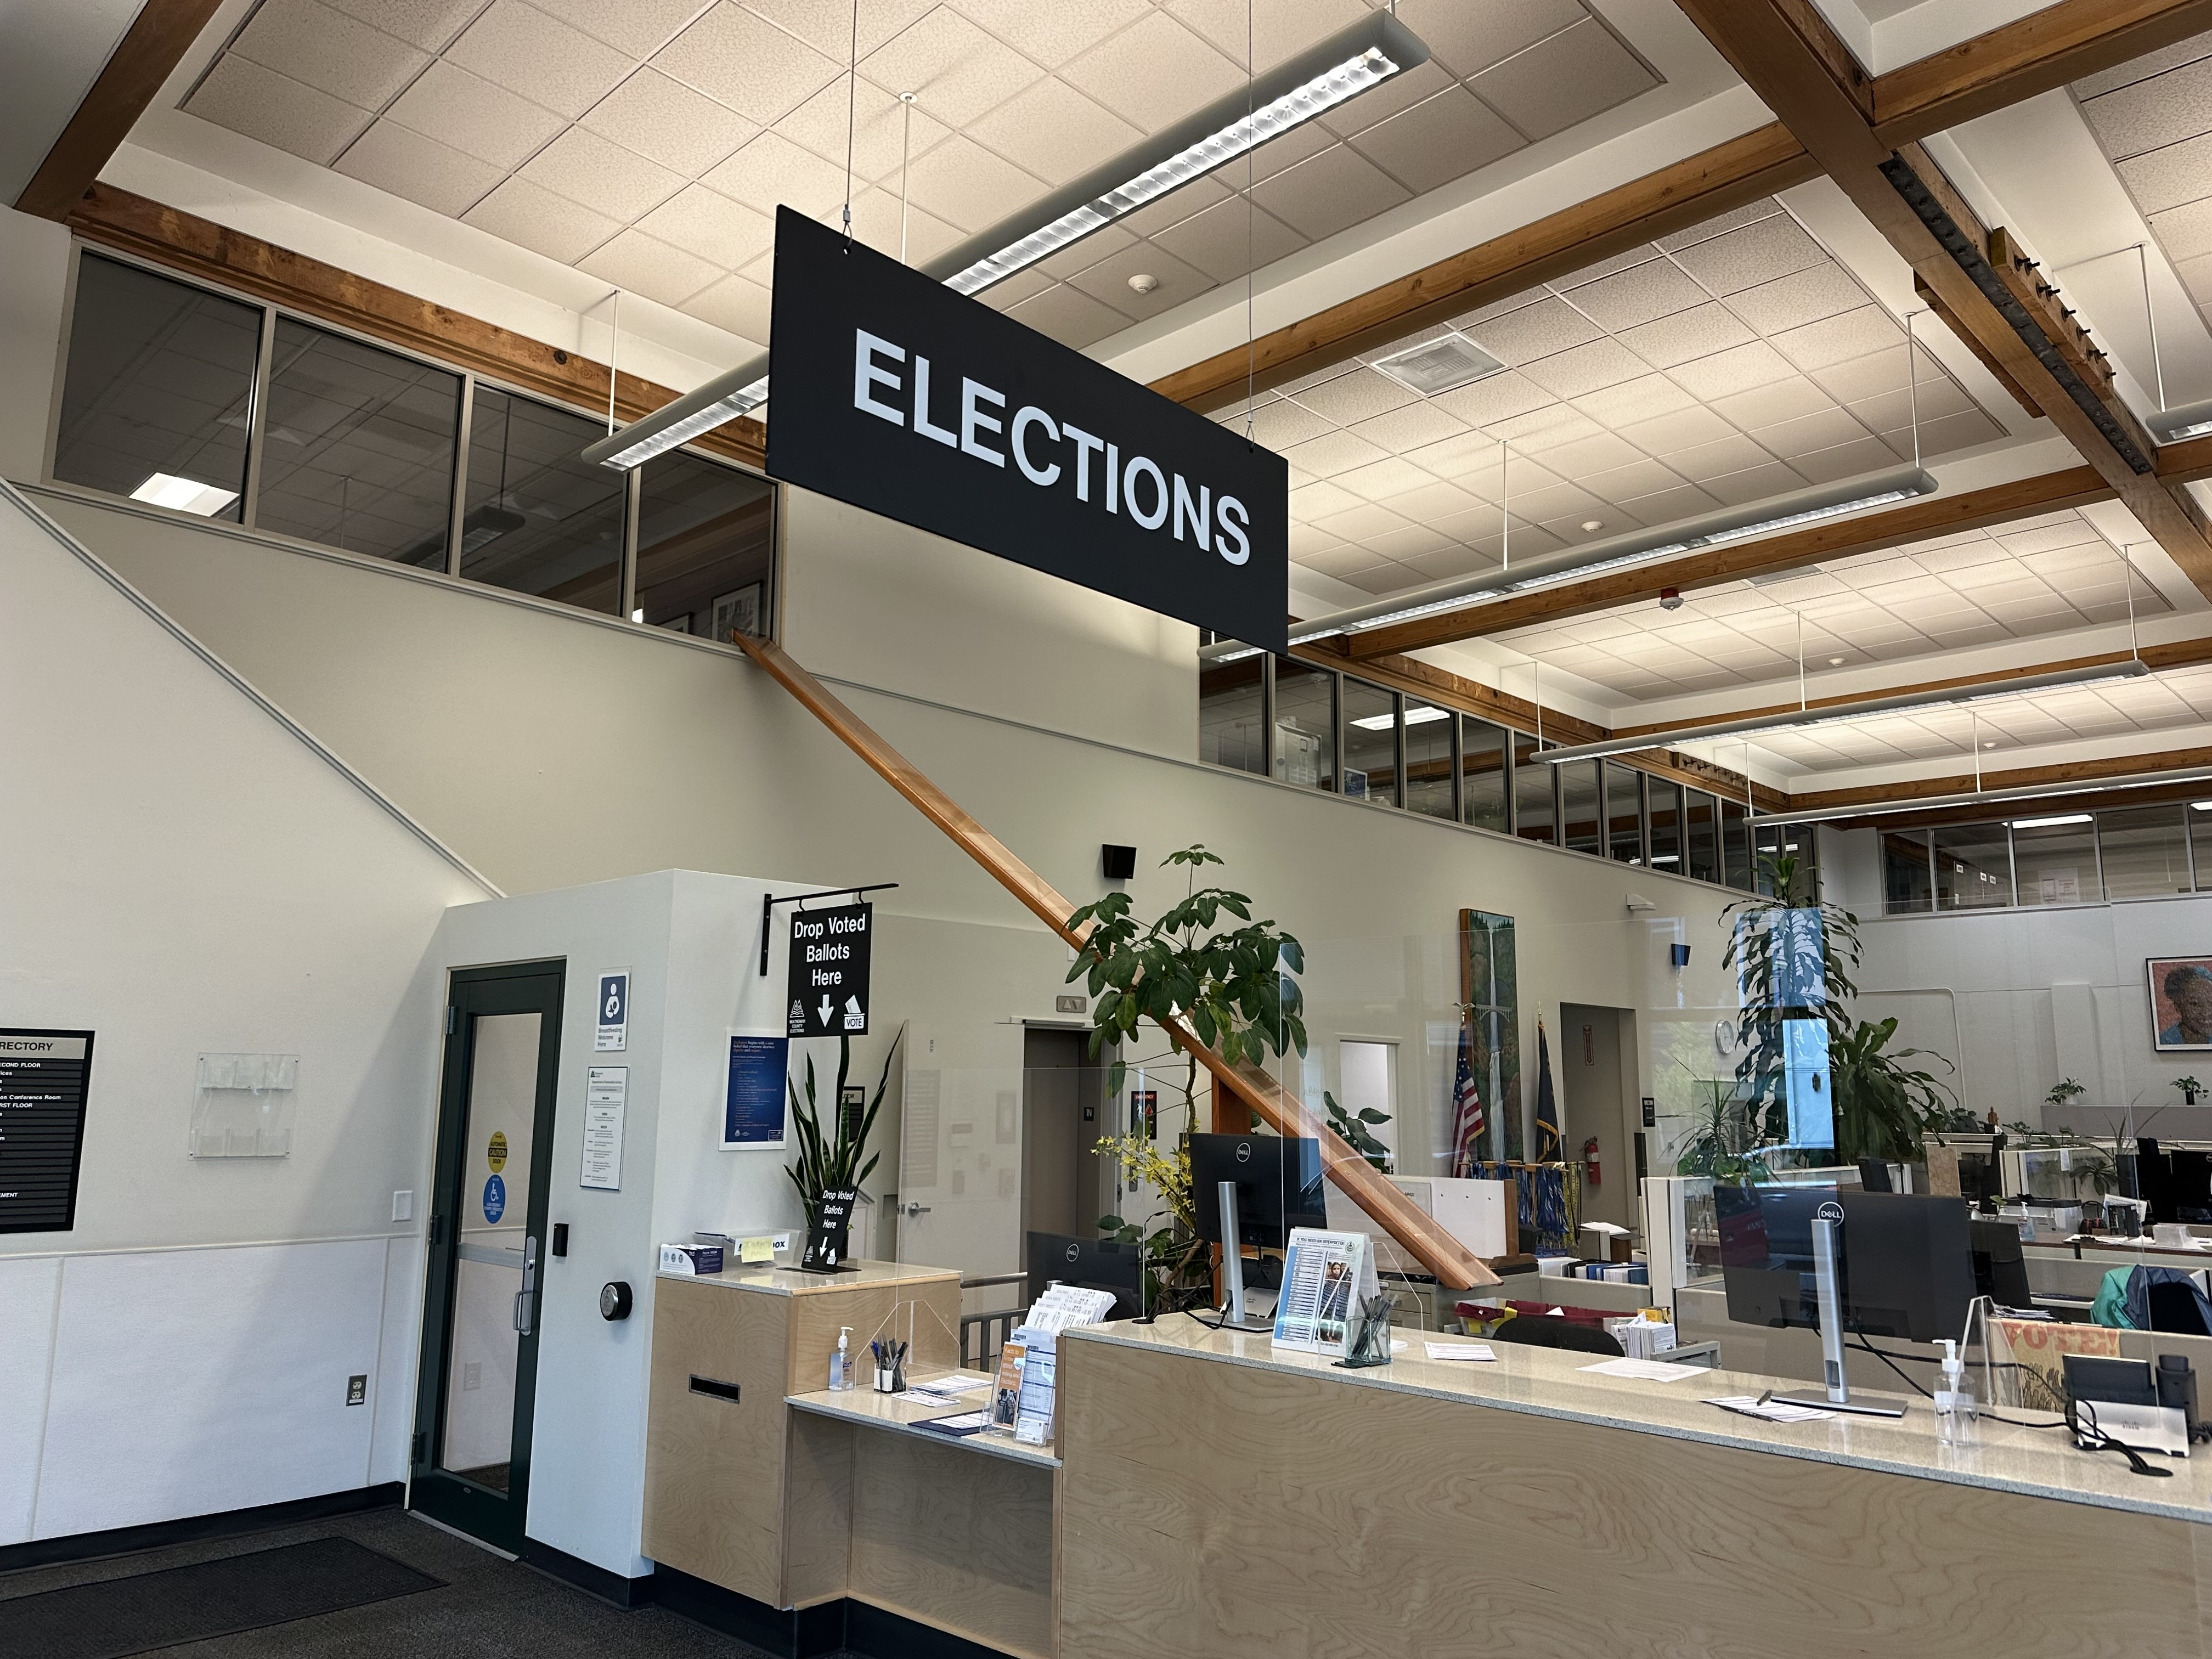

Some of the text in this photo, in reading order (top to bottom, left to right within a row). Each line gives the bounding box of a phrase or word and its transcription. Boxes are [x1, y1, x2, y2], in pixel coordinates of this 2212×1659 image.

[854, 328, 1251, 566] ELECTIONS
[794, 913, 866, 940] Drop Voted
[806, 943, 850, 962] Ballots
[812, 968, 842, 986] Here
[846, 1018, 862, 1027] VOTE
[489, 1148, 506, 1156] CAUTION
[823, 1190, 854, 1201] Drop Voted
[823, 1205, 844, 1215] Ballots
[823, 1219, 837, 1229] Here
[1997, 1322, 2119, 1356] VOTE!
